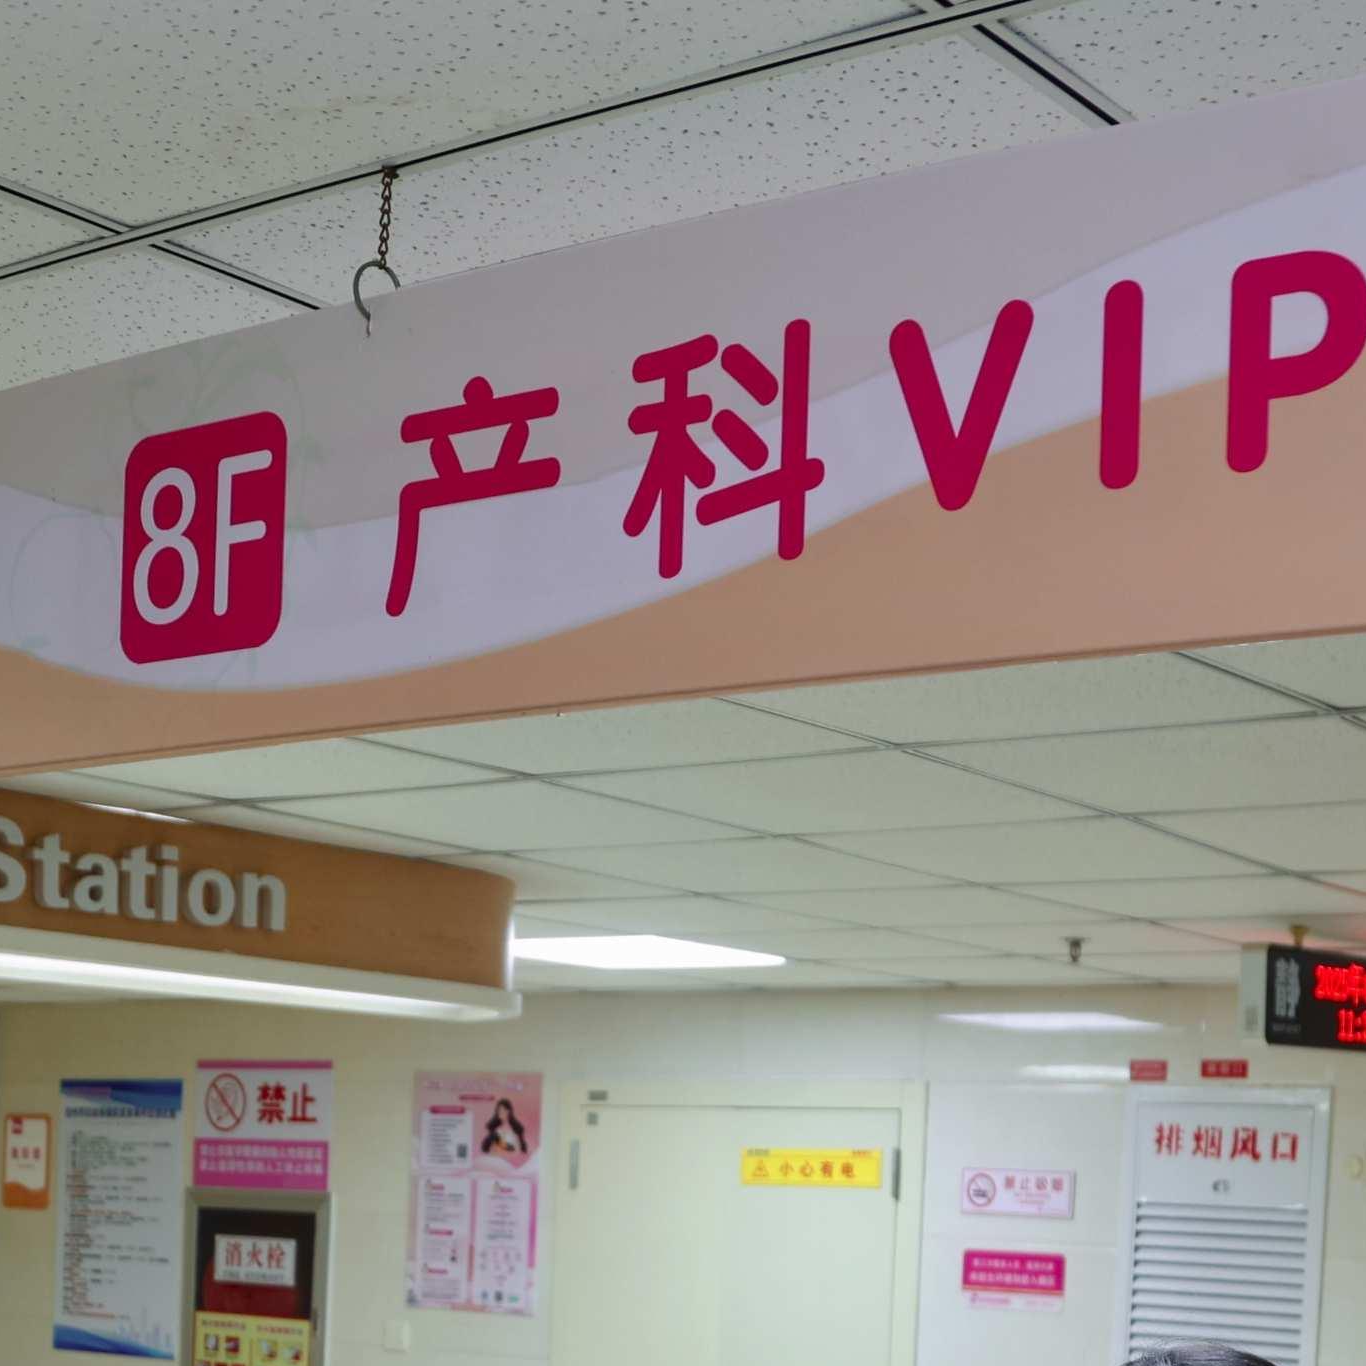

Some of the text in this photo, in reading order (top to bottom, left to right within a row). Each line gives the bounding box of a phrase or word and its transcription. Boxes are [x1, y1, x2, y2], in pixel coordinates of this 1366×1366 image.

[134, 449, 276, 625] 8F
[257, 1082, 318, 1124] 禁止
[1155, 1123, 1299, 1161] 排烟风口
[779, 1159, 856, 1179] 小心有电
[225, 1240, 285, 1270] 消火栓
